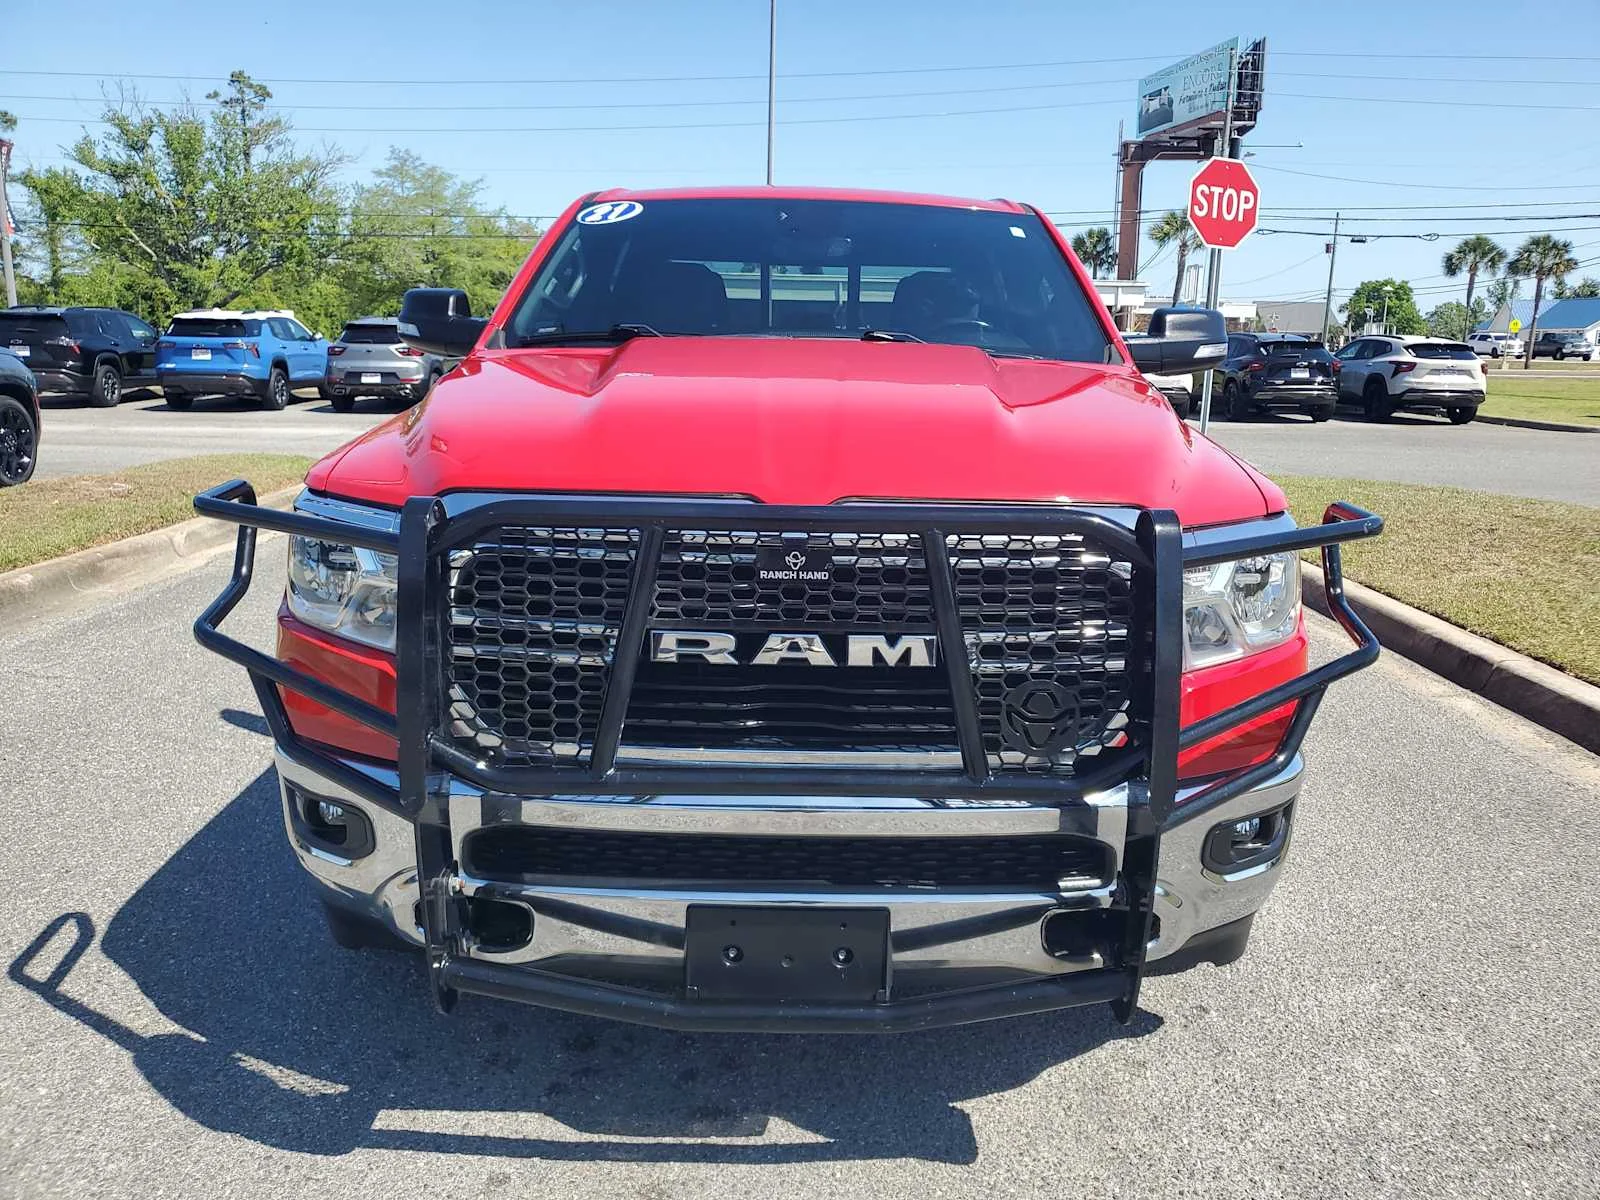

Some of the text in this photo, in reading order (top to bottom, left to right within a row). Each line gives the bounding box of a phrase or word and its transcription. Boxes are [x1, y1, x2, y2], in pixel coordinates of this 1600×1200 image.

[1193, 184, 1255, 223] STOP
[759, 570, 829, 580] RANCH HAND
[650, 630, 937, 668] RAM
